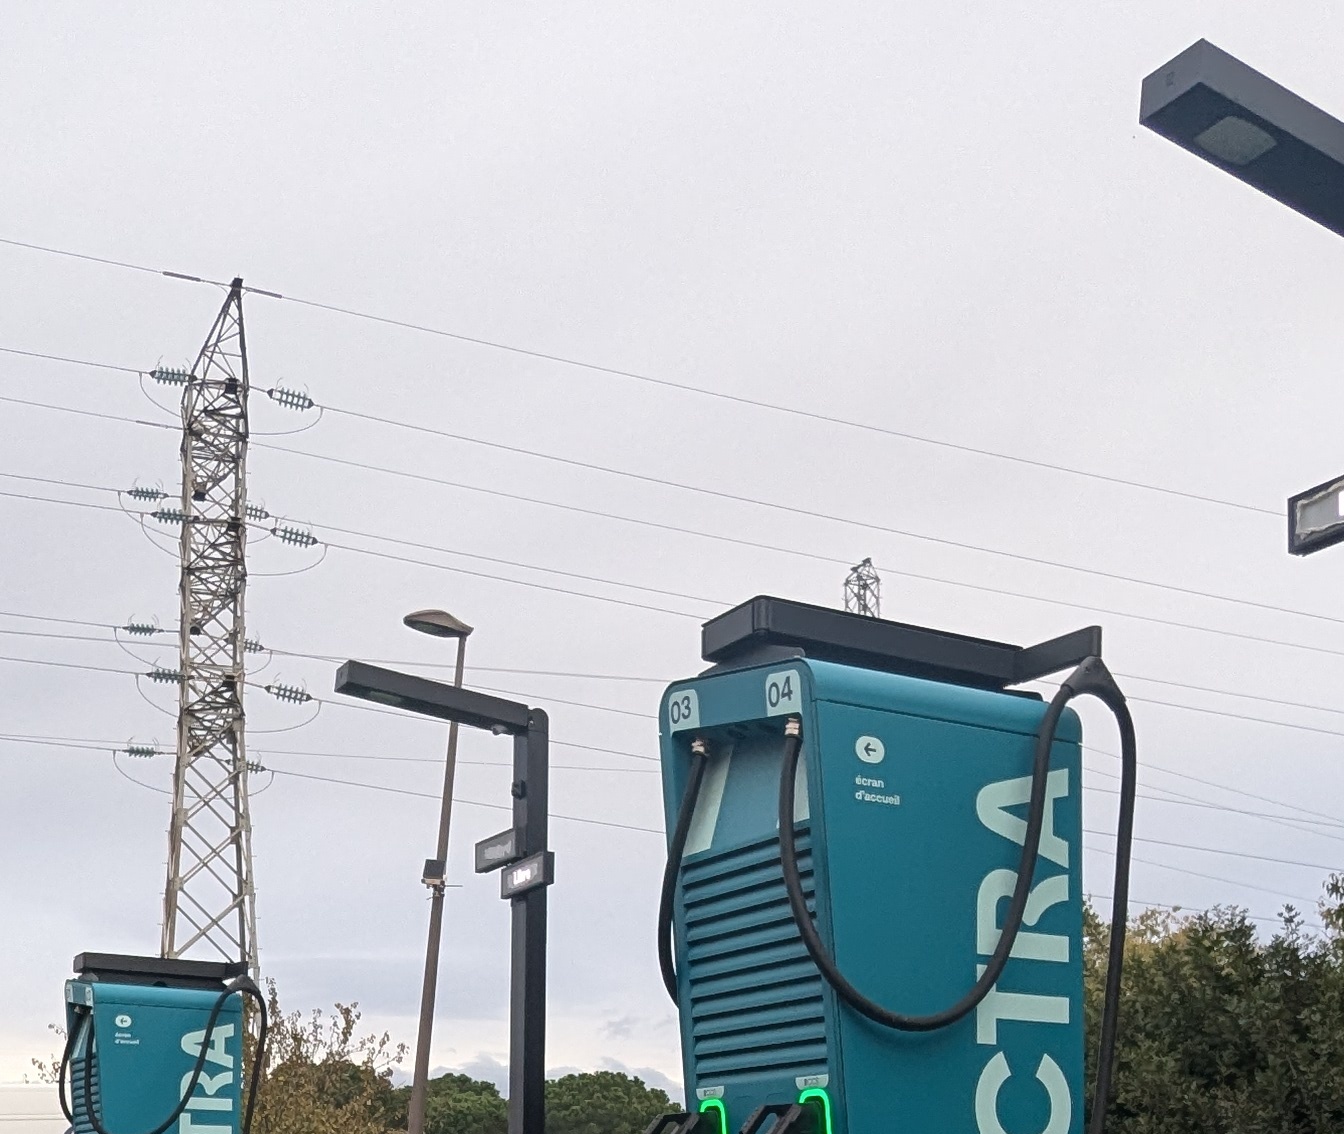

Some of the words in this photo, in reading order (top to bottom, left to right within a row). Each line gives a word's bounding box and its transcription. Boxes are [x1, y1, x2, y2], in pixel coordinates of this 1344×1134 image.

[768, 675, 793, 708] 04
[670, 695, 692, 725] 03
[855, 773, 885, 789] écran
[855, 790, 901, 806] d'accueil
